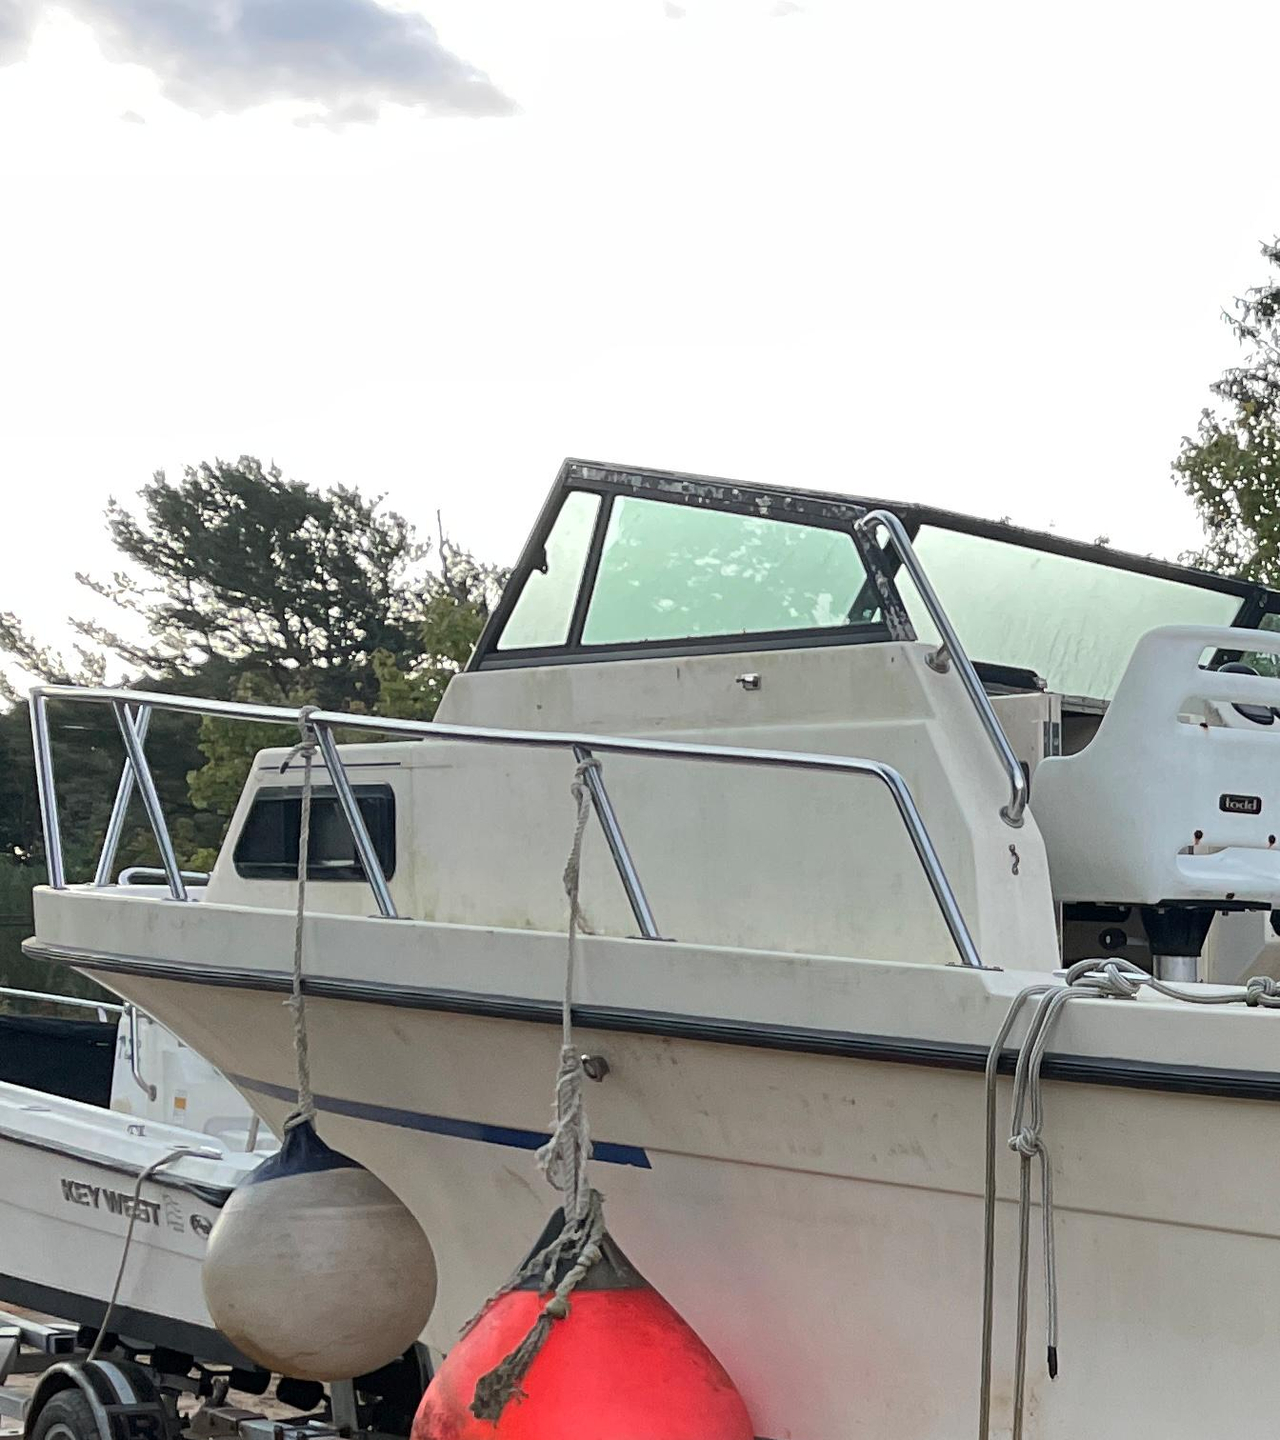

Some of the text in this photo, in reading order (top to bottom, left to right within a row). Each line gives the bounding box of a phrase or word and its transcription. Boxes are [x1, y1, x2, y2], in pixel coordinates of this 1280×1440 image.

[1225, 797, 1257, 810] todd
[61, 1178, 160, 1226] KEY WEST
